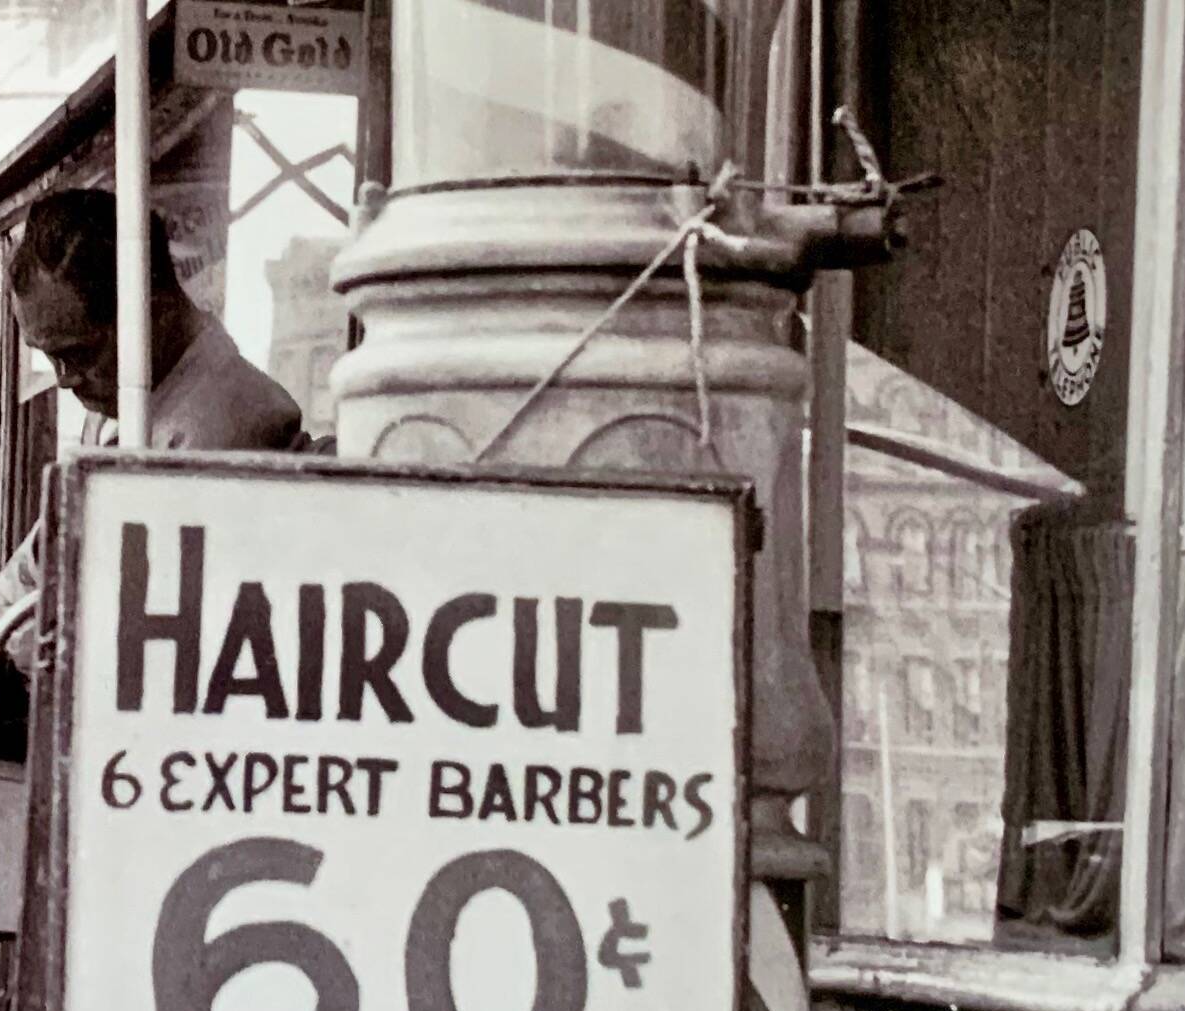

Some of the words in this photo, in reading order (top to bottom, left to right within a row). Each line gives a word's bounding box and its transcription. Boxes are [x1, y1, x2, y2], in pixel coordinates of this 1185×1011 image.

[186, 27, 253, 65] Old
[262, 32, 352, 70] Gold
[117, 522, 679, 734] HAIRCUT
[101, 750, 142, 811] 6
[159, 753, 397, 817] EXPERT
[428, 760, 714, 840] BARBERS
